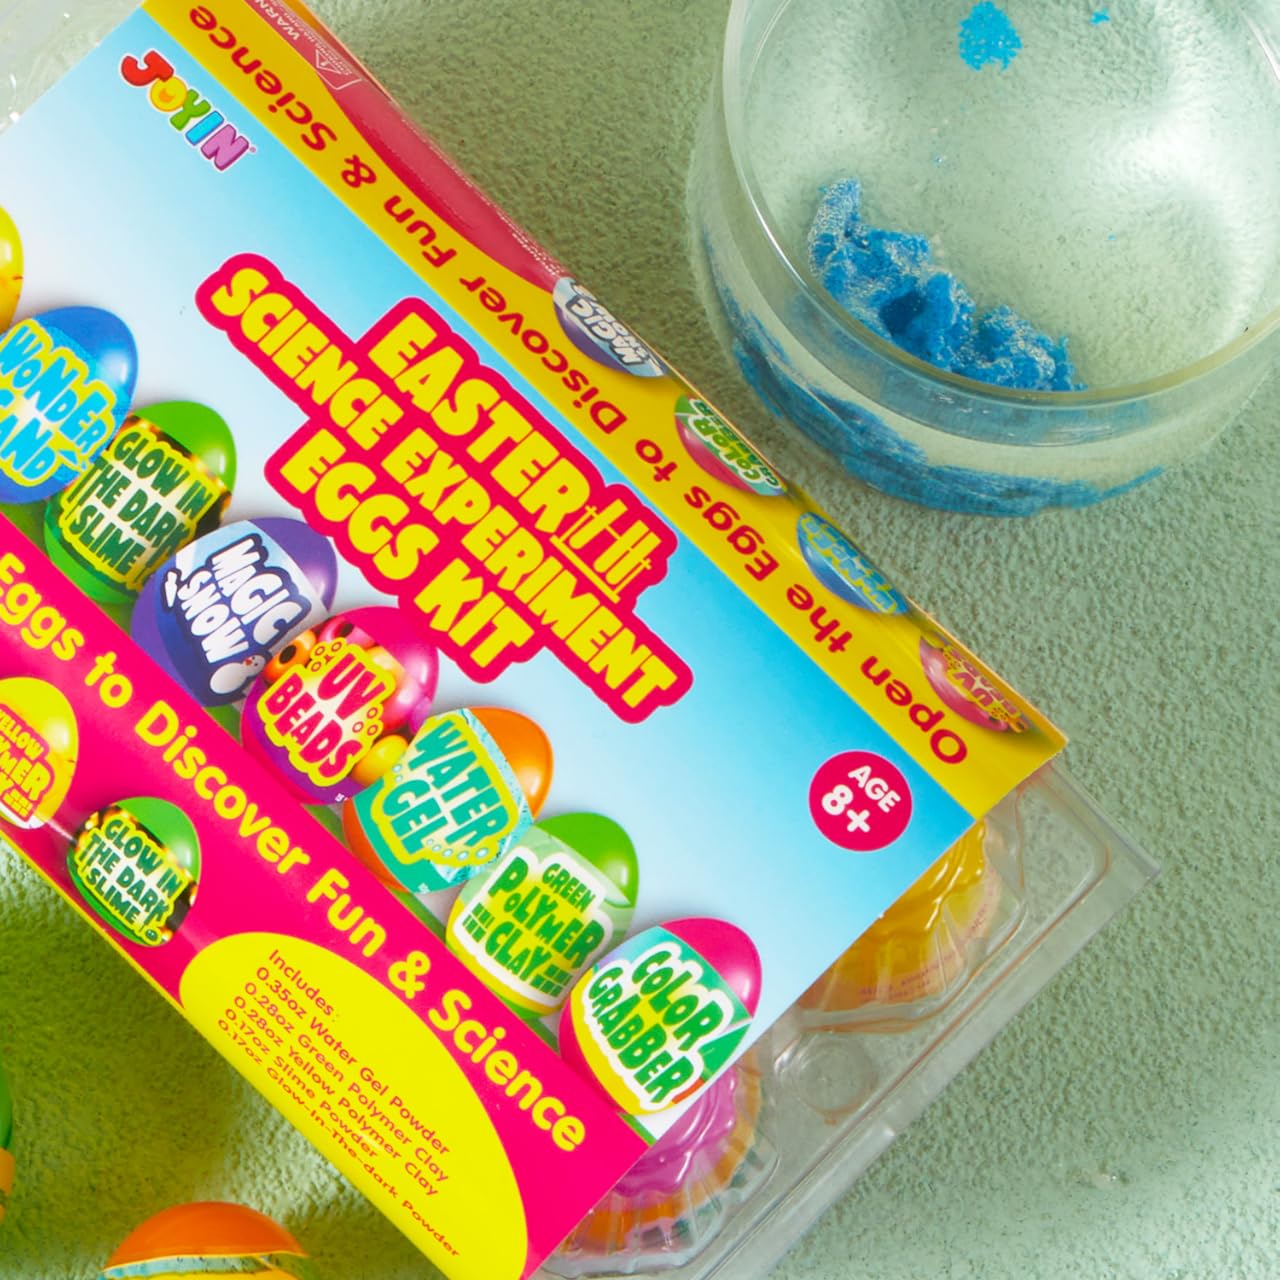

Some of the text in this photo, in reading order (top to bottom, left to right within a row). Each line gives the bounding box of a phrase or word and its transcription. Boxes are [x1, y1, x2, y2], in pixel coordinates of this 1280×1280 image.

[120, 50, 250, 170] JOYIN
[189, 5, 336, 151] Science
[342, 155, 376, 189] &
[384, 194, 456, 266] Fun
[461, 272, 626, 434] Discover
[368, 312, 589, 534] EASTER
[636, 438, 678, 482] to
[693, 419, 761, 479] COLOR
[67, 457, 190, 568] THE DARK
[114, 432, 213, 520] GLOW IN
[211, 268, 678, 708] SCIENCE EXPERIMENT
[69, 504, 147, 576] SLIME
[280, 429, 534, 668] EGGS KIT
[685, 484, 779, 581] Eggs
[177, 570, 249, 663] SNOW
[211, 538, 303, 645] MAGIC
[787, 583, 853, 653] the
[266, 679, 365, 780] BEADS
[318, 653, 387, 721] UV
[861, 655, 968, 765] Open
[384, 778, 448, 853] GEL
[414, 720, 508, 848] WATER
[822, 785, 870, 833] 8+
[848, 765, 900, 812] AGE
[78, 833, 169, 926] THE DARK
[84, 651, 132, 709] to
[135, 700, 310, 874] Discover
[307, 868, 387, 956] Fun
[388, 951, 430, 998] &
[429, 990, 586, 1152] Science
[86, 868, 141, 925] SLIME
[104, 819, 183, 898] GLOW IN
[542, 863, 595, 911] GREEN
[484, 922, 545, 984] CLAY
[487, 855, 606, 970] POLYMER
[589, 967, 695, 1102] GRABBER
[632, 949, 725, 1053] COLOR
[225, 1008, 378, 1158] 0.17oz Slime Powder
[234, 996, 438, 1196] 0.28oz Yellow Polymer Clay
[245, 982, 449, 1182] 0.28oz Green Polymer Clay
[257, 967, 449, 1154] 0.35oz Water Gel Powder
[218, 1019, 262, 1064] 0.17oz
[402, 1200, 460, 1256] Powder
